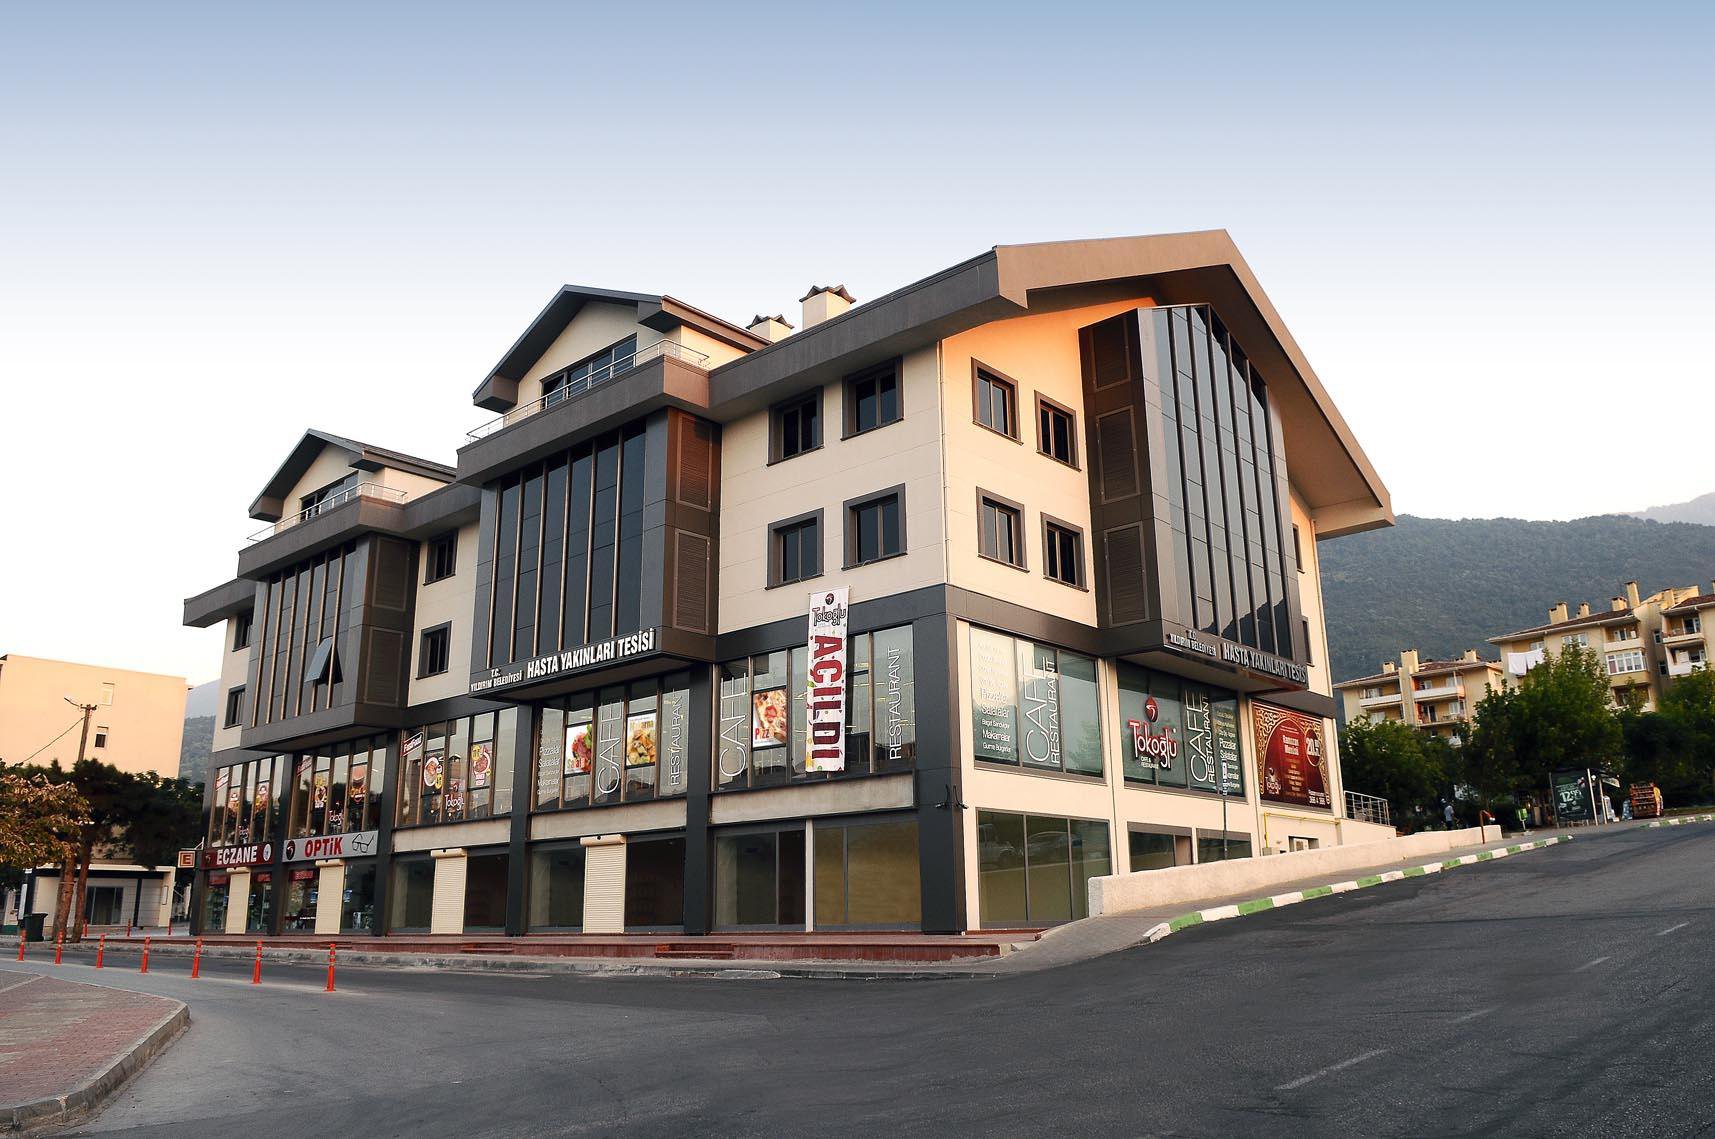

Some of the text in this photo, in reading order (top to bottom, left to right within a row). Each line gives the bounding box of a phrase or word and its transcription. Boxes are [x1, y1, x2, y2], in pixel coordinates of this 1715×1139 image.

[527, 628, 655, 679] HASTA YAKINLARI TESİSİ
[810, 635, 843, 759] AÇILDI
[597, 699, 623, 794] CAFE
[720, 672, 748, 777] CAFE
[887, 647, 902, 760] RESTAURANT
[1022, 650, 1050, 762] CAFE
[1045, 660, 1061, 764] RESTAURANT
[1128, 720, 1177, 770] Tokoğlu
[1184, 688, 1208, 782] CAFE
[182, 854, 192, 865] E
[216, 845, 258, 865] ECZANE
